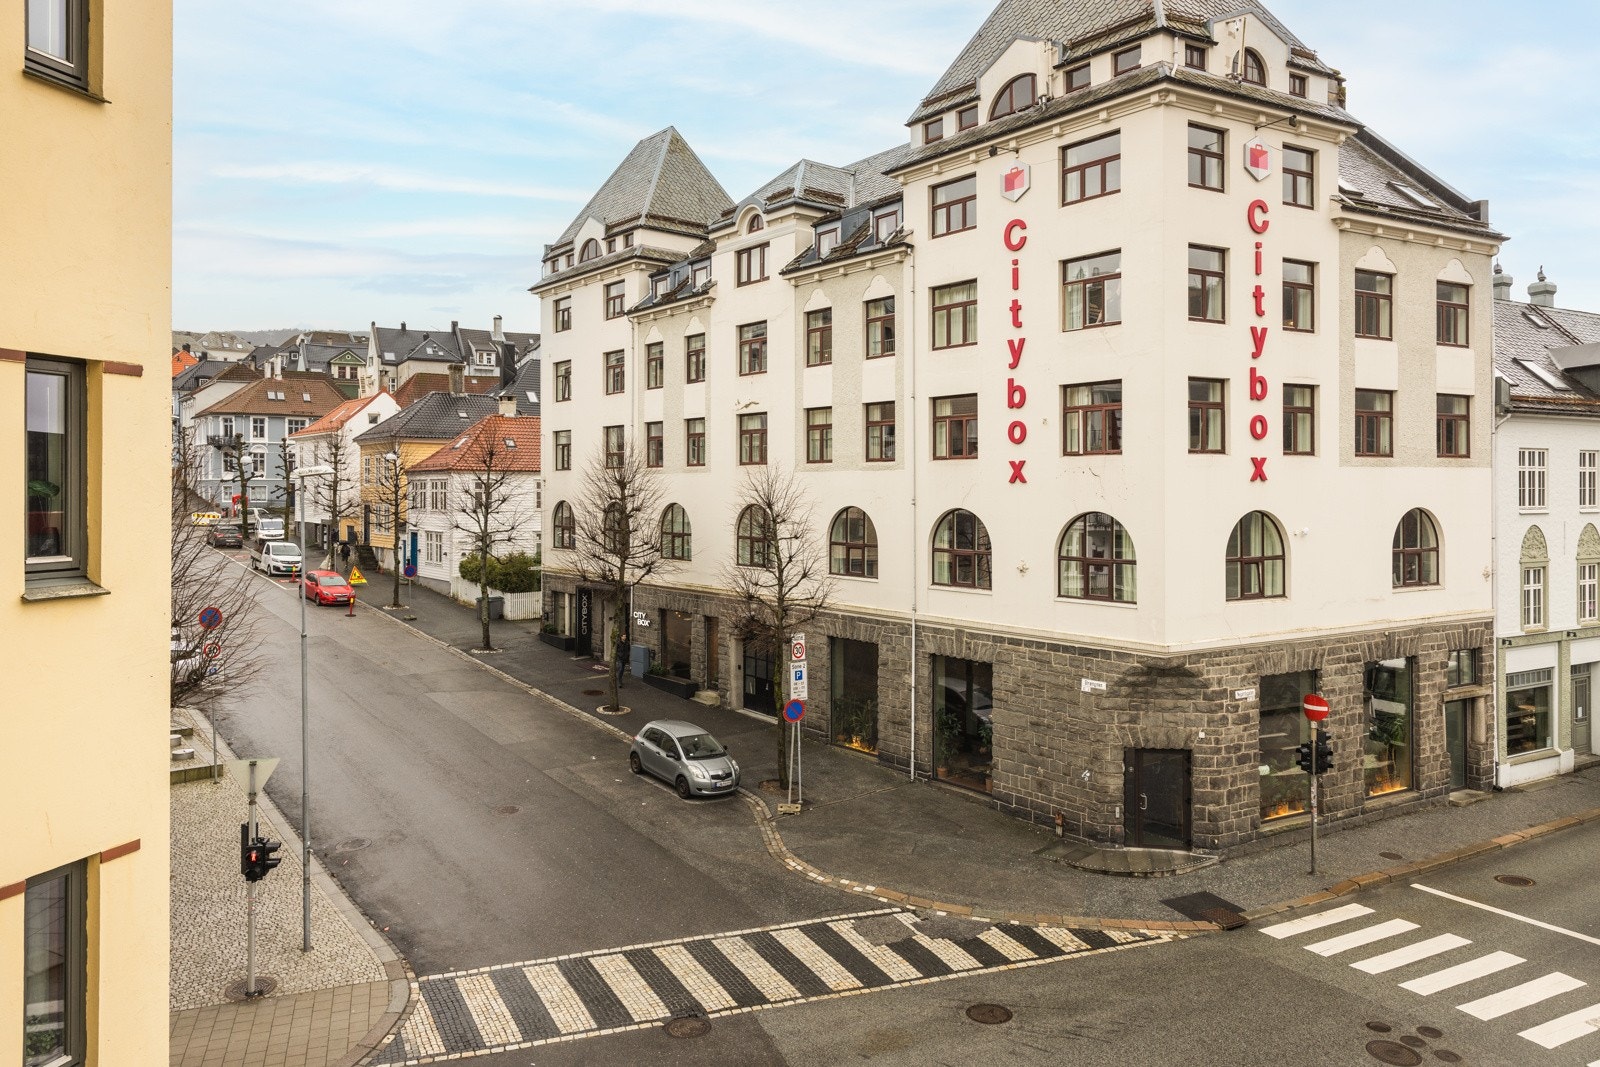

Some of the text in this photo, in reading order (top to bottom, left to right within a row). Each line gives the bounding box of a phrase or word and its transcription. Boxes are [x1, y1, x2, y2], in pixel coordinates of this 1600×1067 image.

[1004, 219, 1027, 483] Citybox
[1248, 199, 1270, 480] Citybox
[633, 611, 646, 619] CITY
[637, 619, 651, 627] BOX
